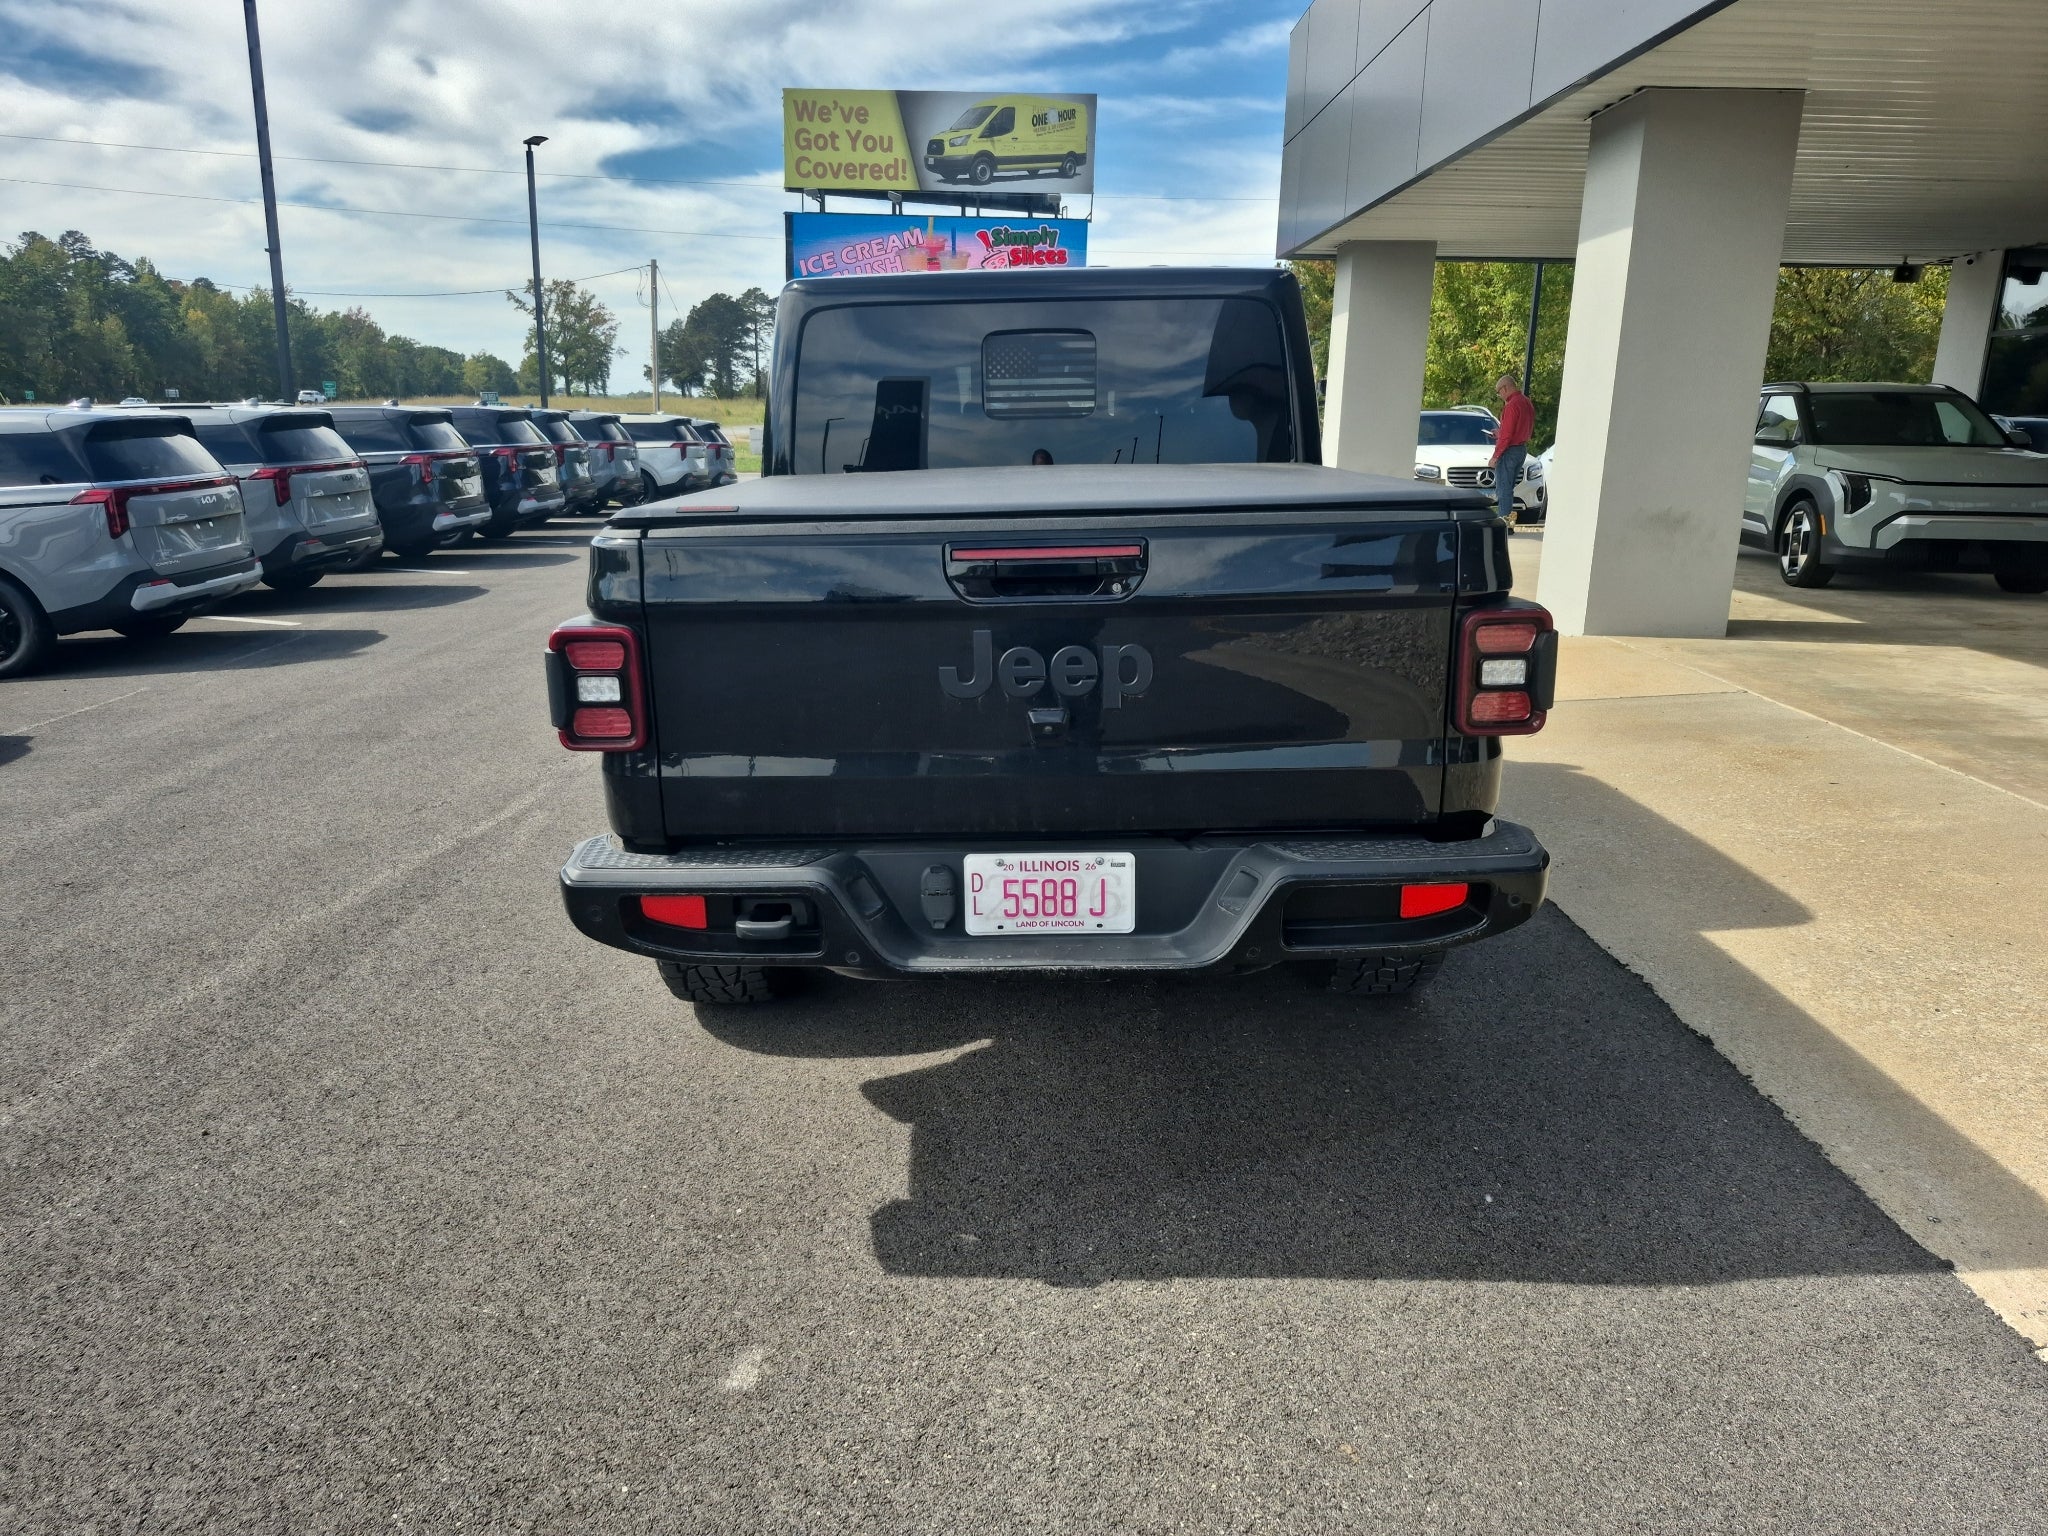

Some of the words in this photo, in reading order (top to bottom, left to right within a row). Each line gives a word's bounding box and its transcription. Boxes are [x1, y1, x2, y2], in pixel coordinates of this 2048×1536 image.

[793, 99, 869, 124] We've
[1032, 113, 1048, 127] ONE
[1058, 109, 1076, 122] HOUR
[794, 128, 840, 151] Got
[845, 129, 894, 153] You
[795, 156, 907, 181] Covered!
[990, 227, 1059, 249] Simply
[800, 249, 838, 277] ICE
[840, 228, 925, 265] CREAM
[1009, 248, 1068, 267] Slices
[938, 629, 1153, 709] Jeep
[1019, 860, 1080, 872] ILLINOIS
[1003, 878, 1077, 918] 5588
[1089, 878, 1106, 917] J
[1039, 920, 1050, 928] OF
[1051, 920, 1085, 928] LINCOLN
